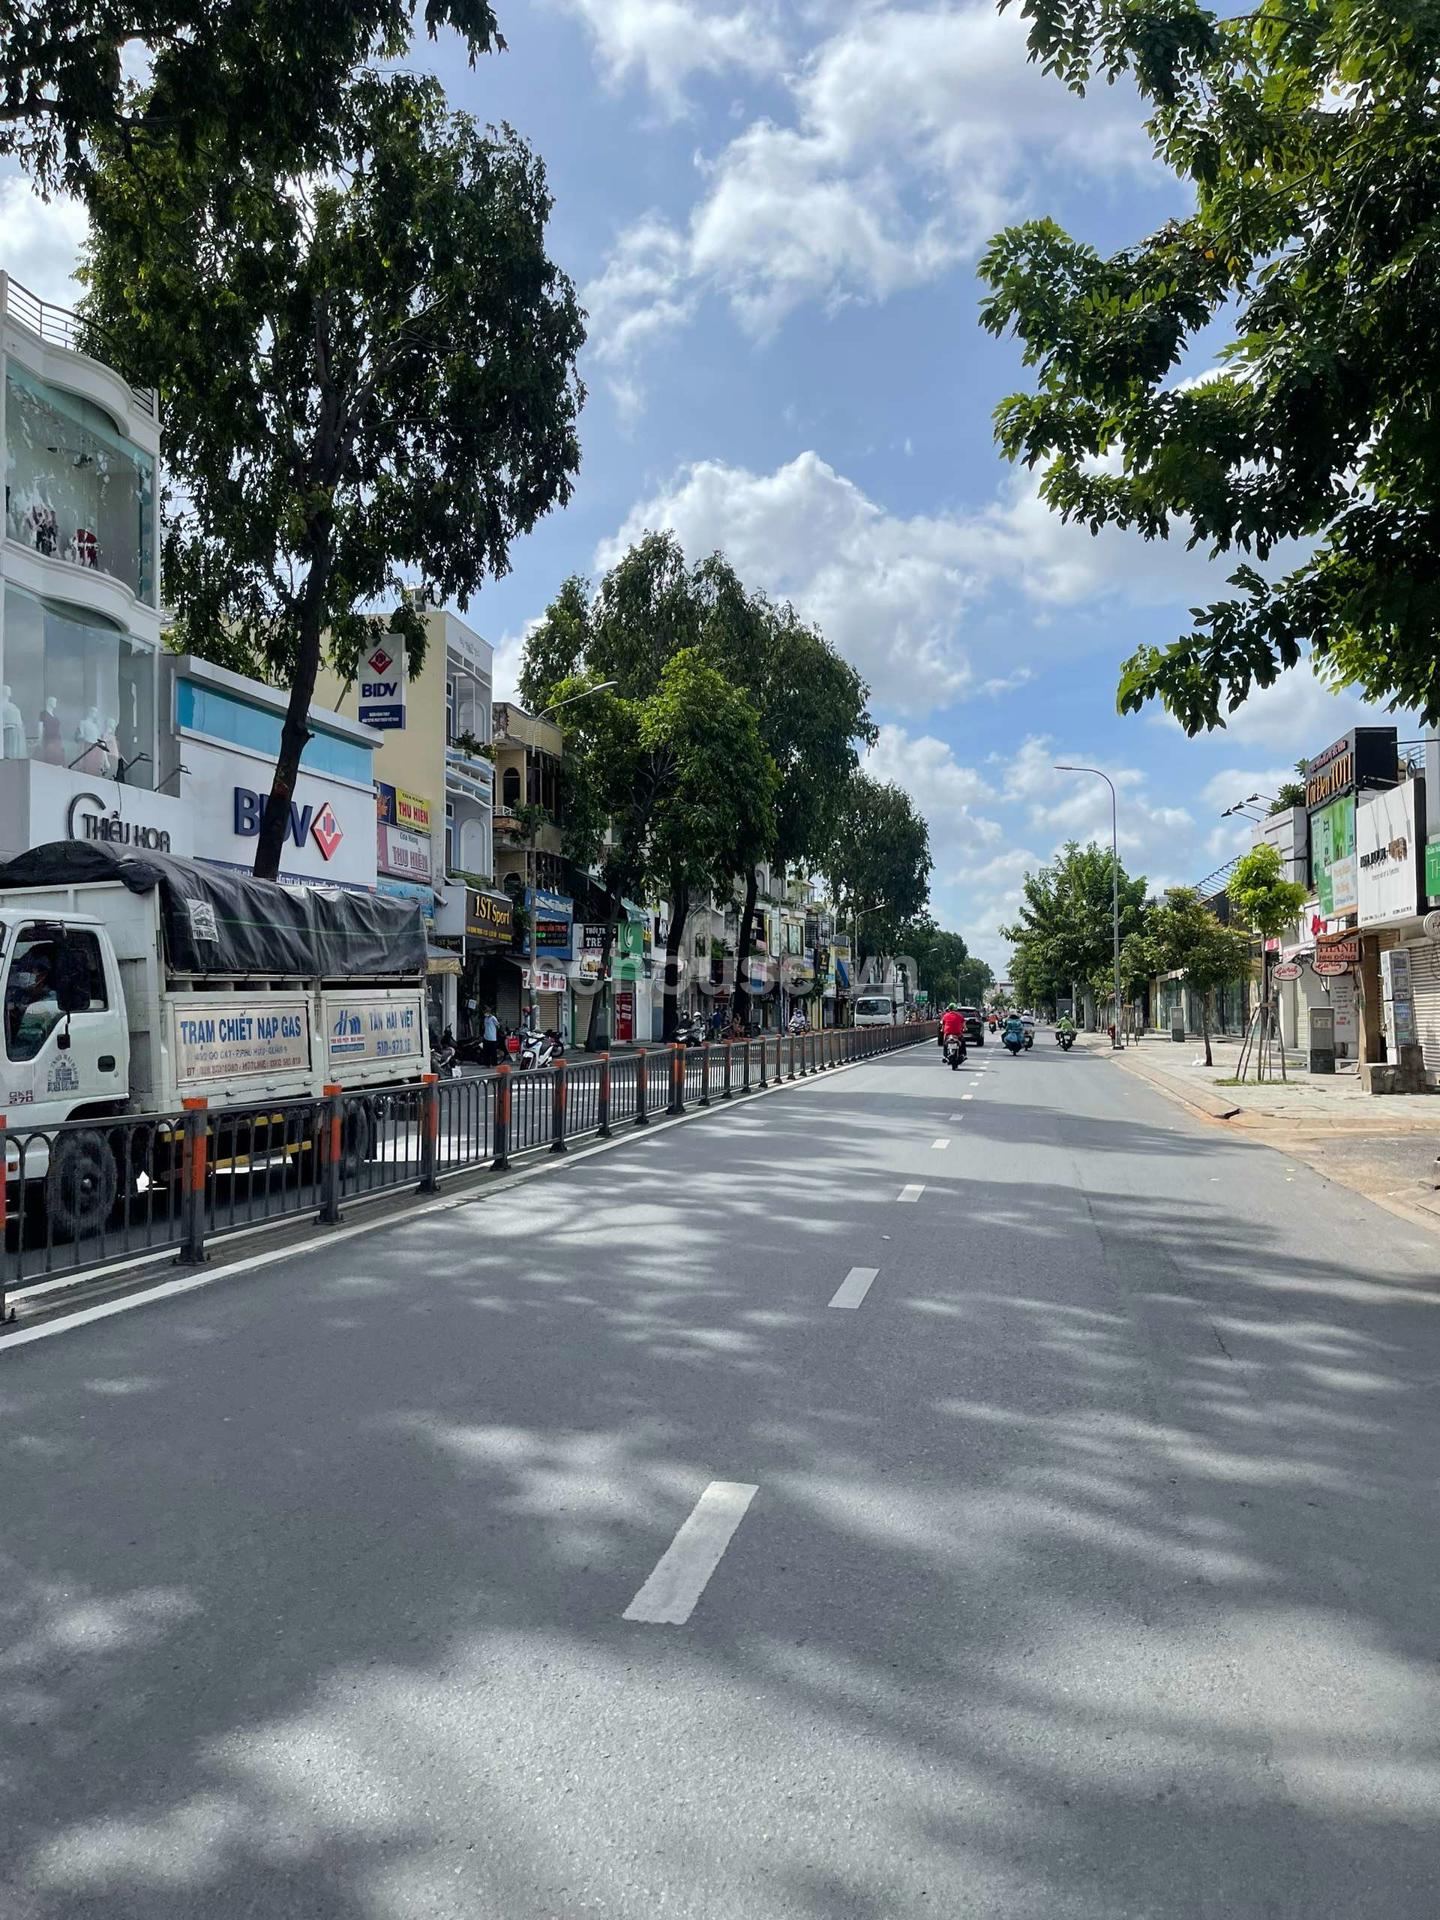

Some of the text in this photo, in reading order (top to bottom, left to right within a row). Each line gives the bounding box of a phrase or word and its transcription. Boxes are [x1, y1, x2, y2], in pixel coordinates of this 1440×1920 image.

[361, 681, 398, 698] BIDV
[133, 824, 171, 853] HOA
[474, 895, 493, 919] 1ST
[491, 904, 510, 927] Sport
[180, 1010, 301, 1051] TRẠM CHIẾT NẠP GAS
